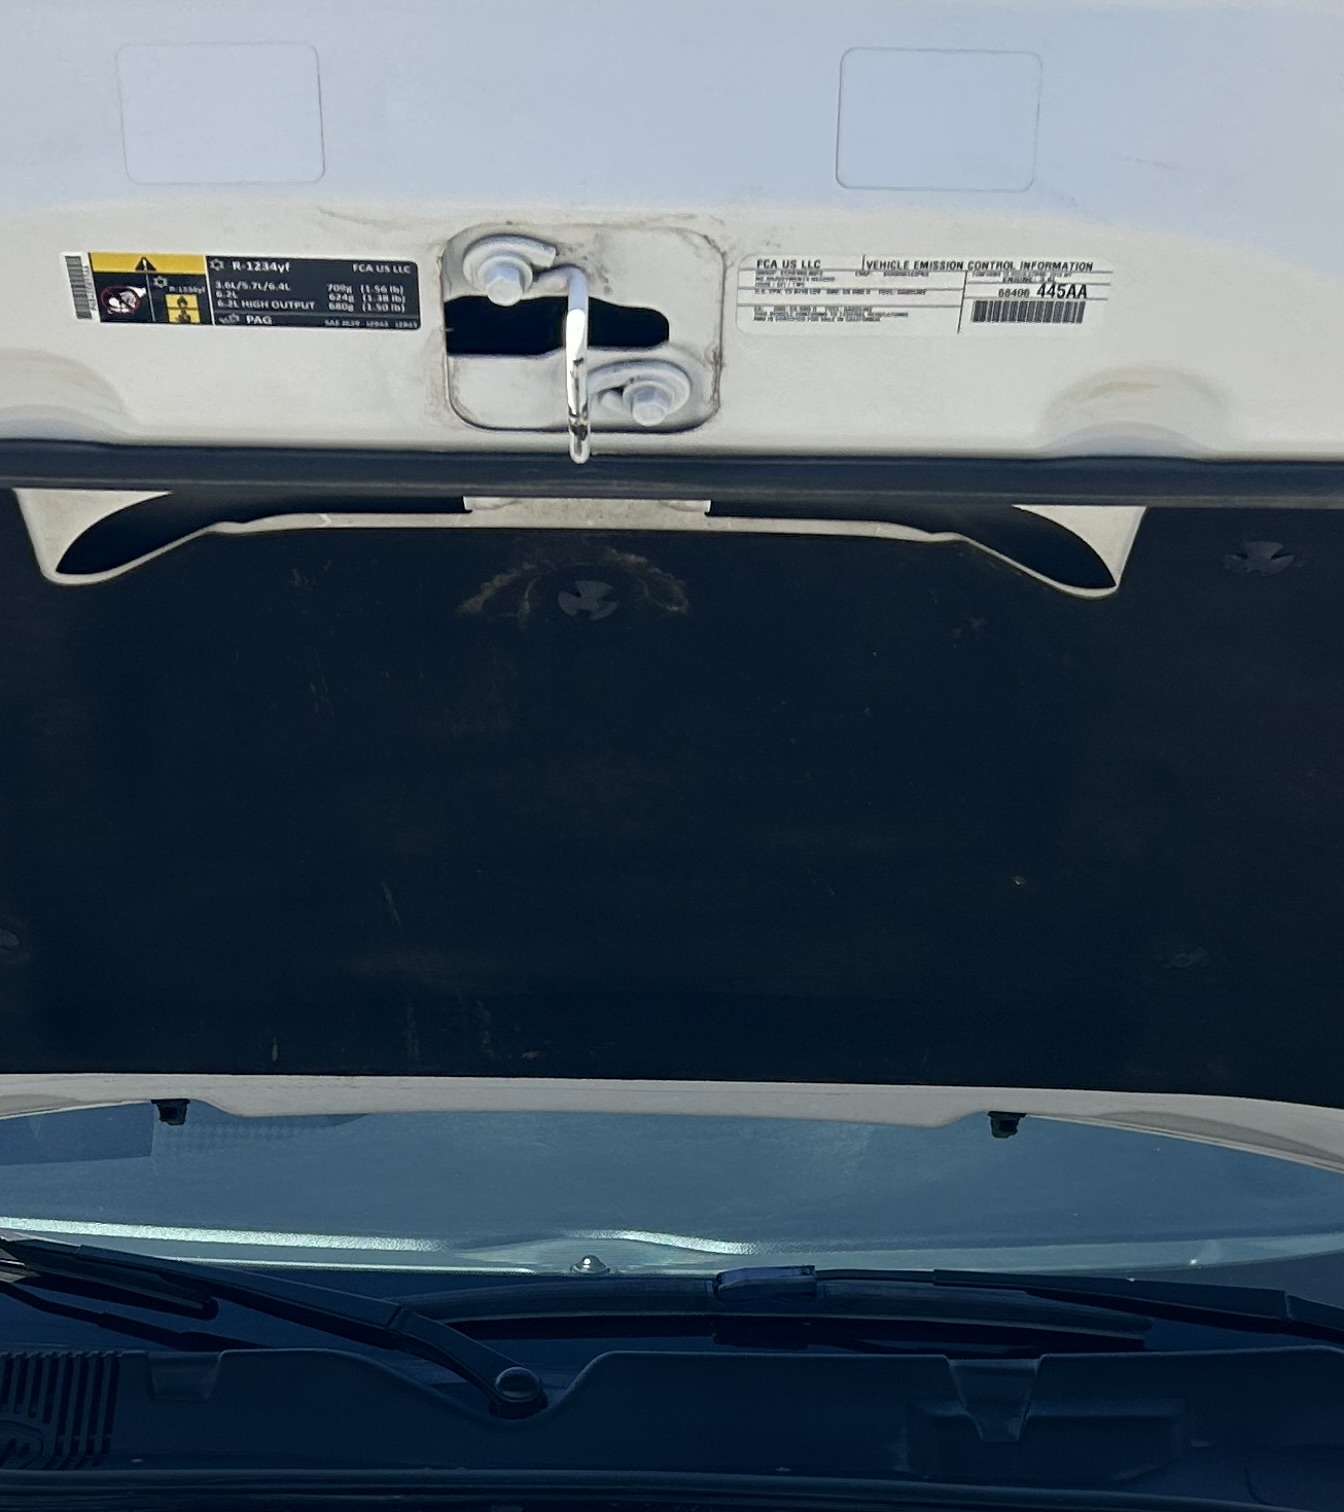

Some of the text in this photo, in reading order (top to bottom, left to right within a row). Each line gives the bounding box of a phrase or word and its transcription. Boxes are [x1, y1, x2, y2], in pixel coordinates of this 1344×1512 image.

[232, 261, 290, 274] R-1234yf
[352, 263, 411, 274] FCA US LLC
[757, 260, 1094, 272] FCA US LLC VEHICLE EMISSION CONTROL INFORMATION
[1036, 283, 1087, 300] 445AA
[241, 300, 269, 309] HIGH
[271, 301, 315, 310] OUTPUT
[246, 315, 272, 325] PAG
